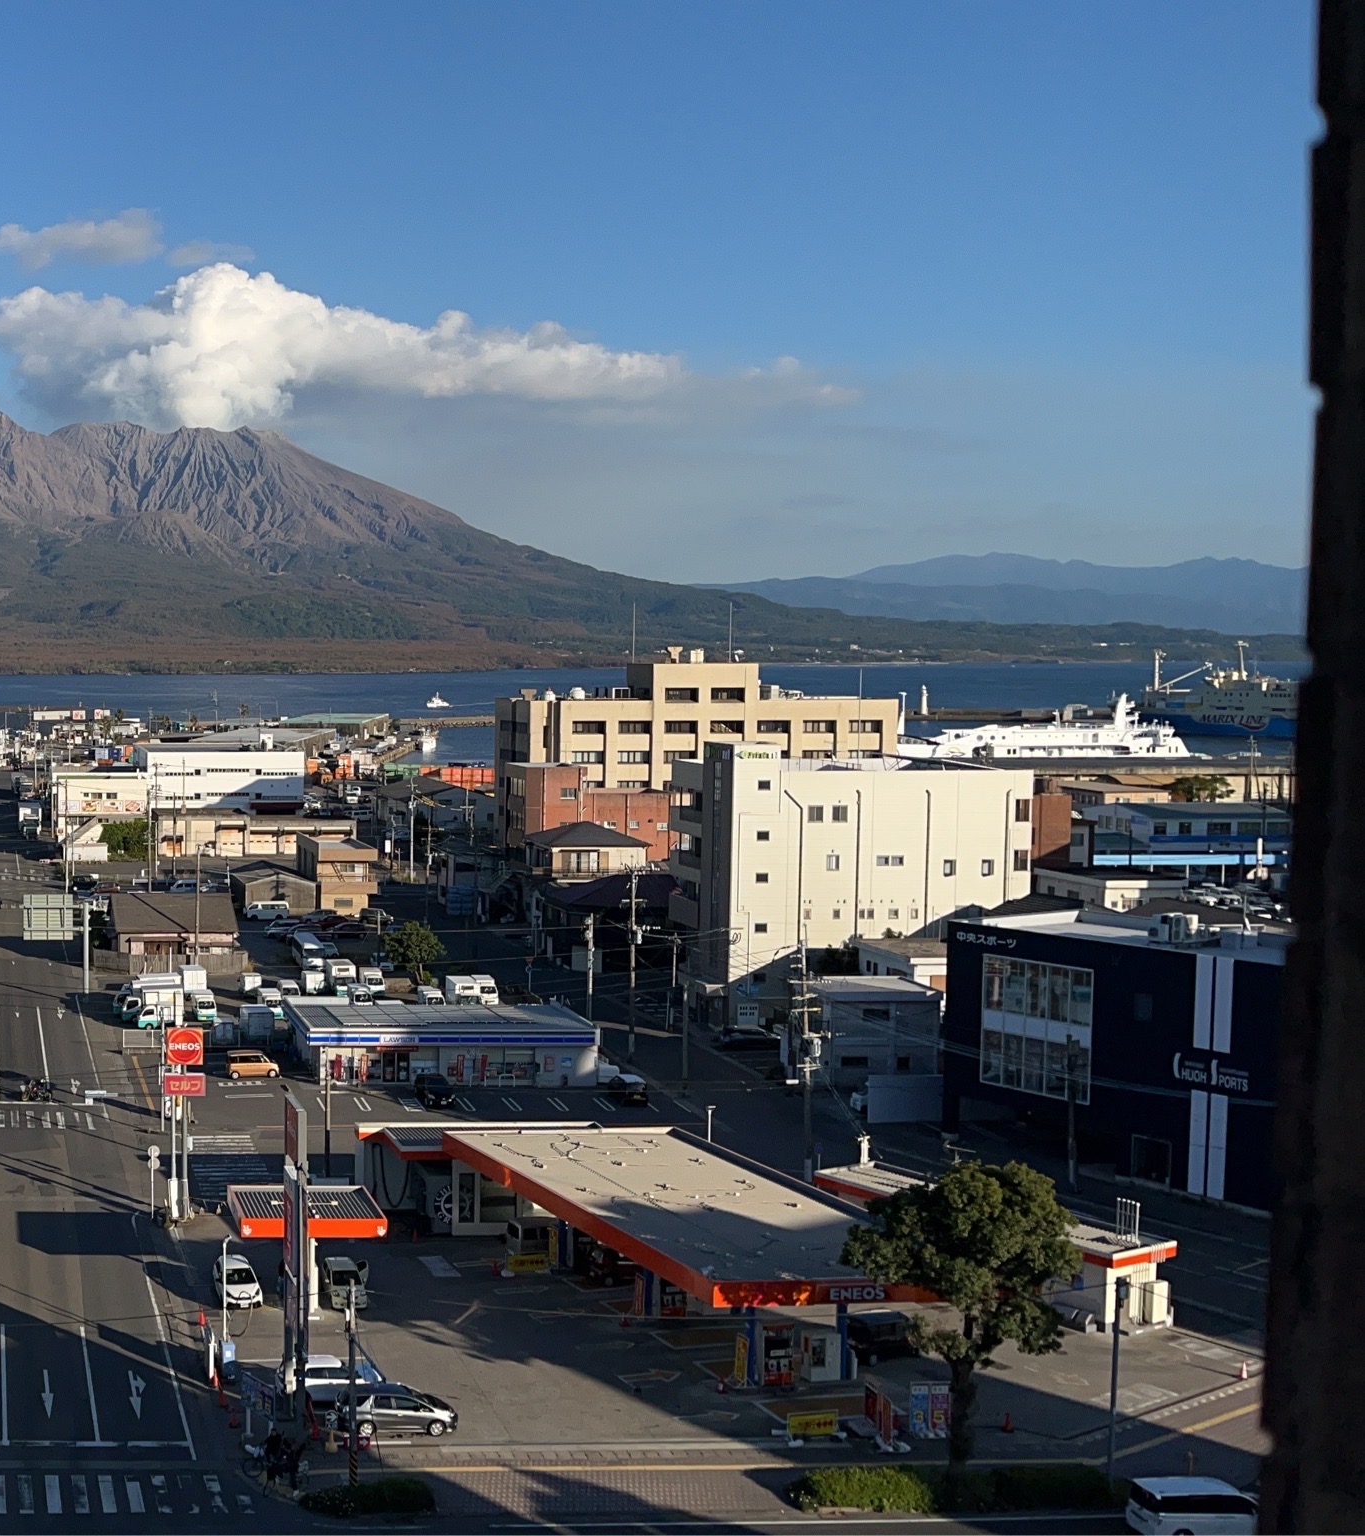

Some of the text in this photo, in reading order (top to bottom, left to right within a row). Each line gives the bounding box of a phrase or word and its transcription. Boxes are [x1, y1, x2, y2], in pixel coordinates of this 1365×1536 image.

[1199, 713, 1267, 725] MARIX LINE
[956, 931, 1017, 949] 中央スポーツ
[168, 1042, 201, 1051] ENEOS
[1173, 1052, 1249, 1092] CHUOH SPORTS
[169, 1080, 201, 1091] セルフ
[829, 1286, 885, 1301] ENEOS
